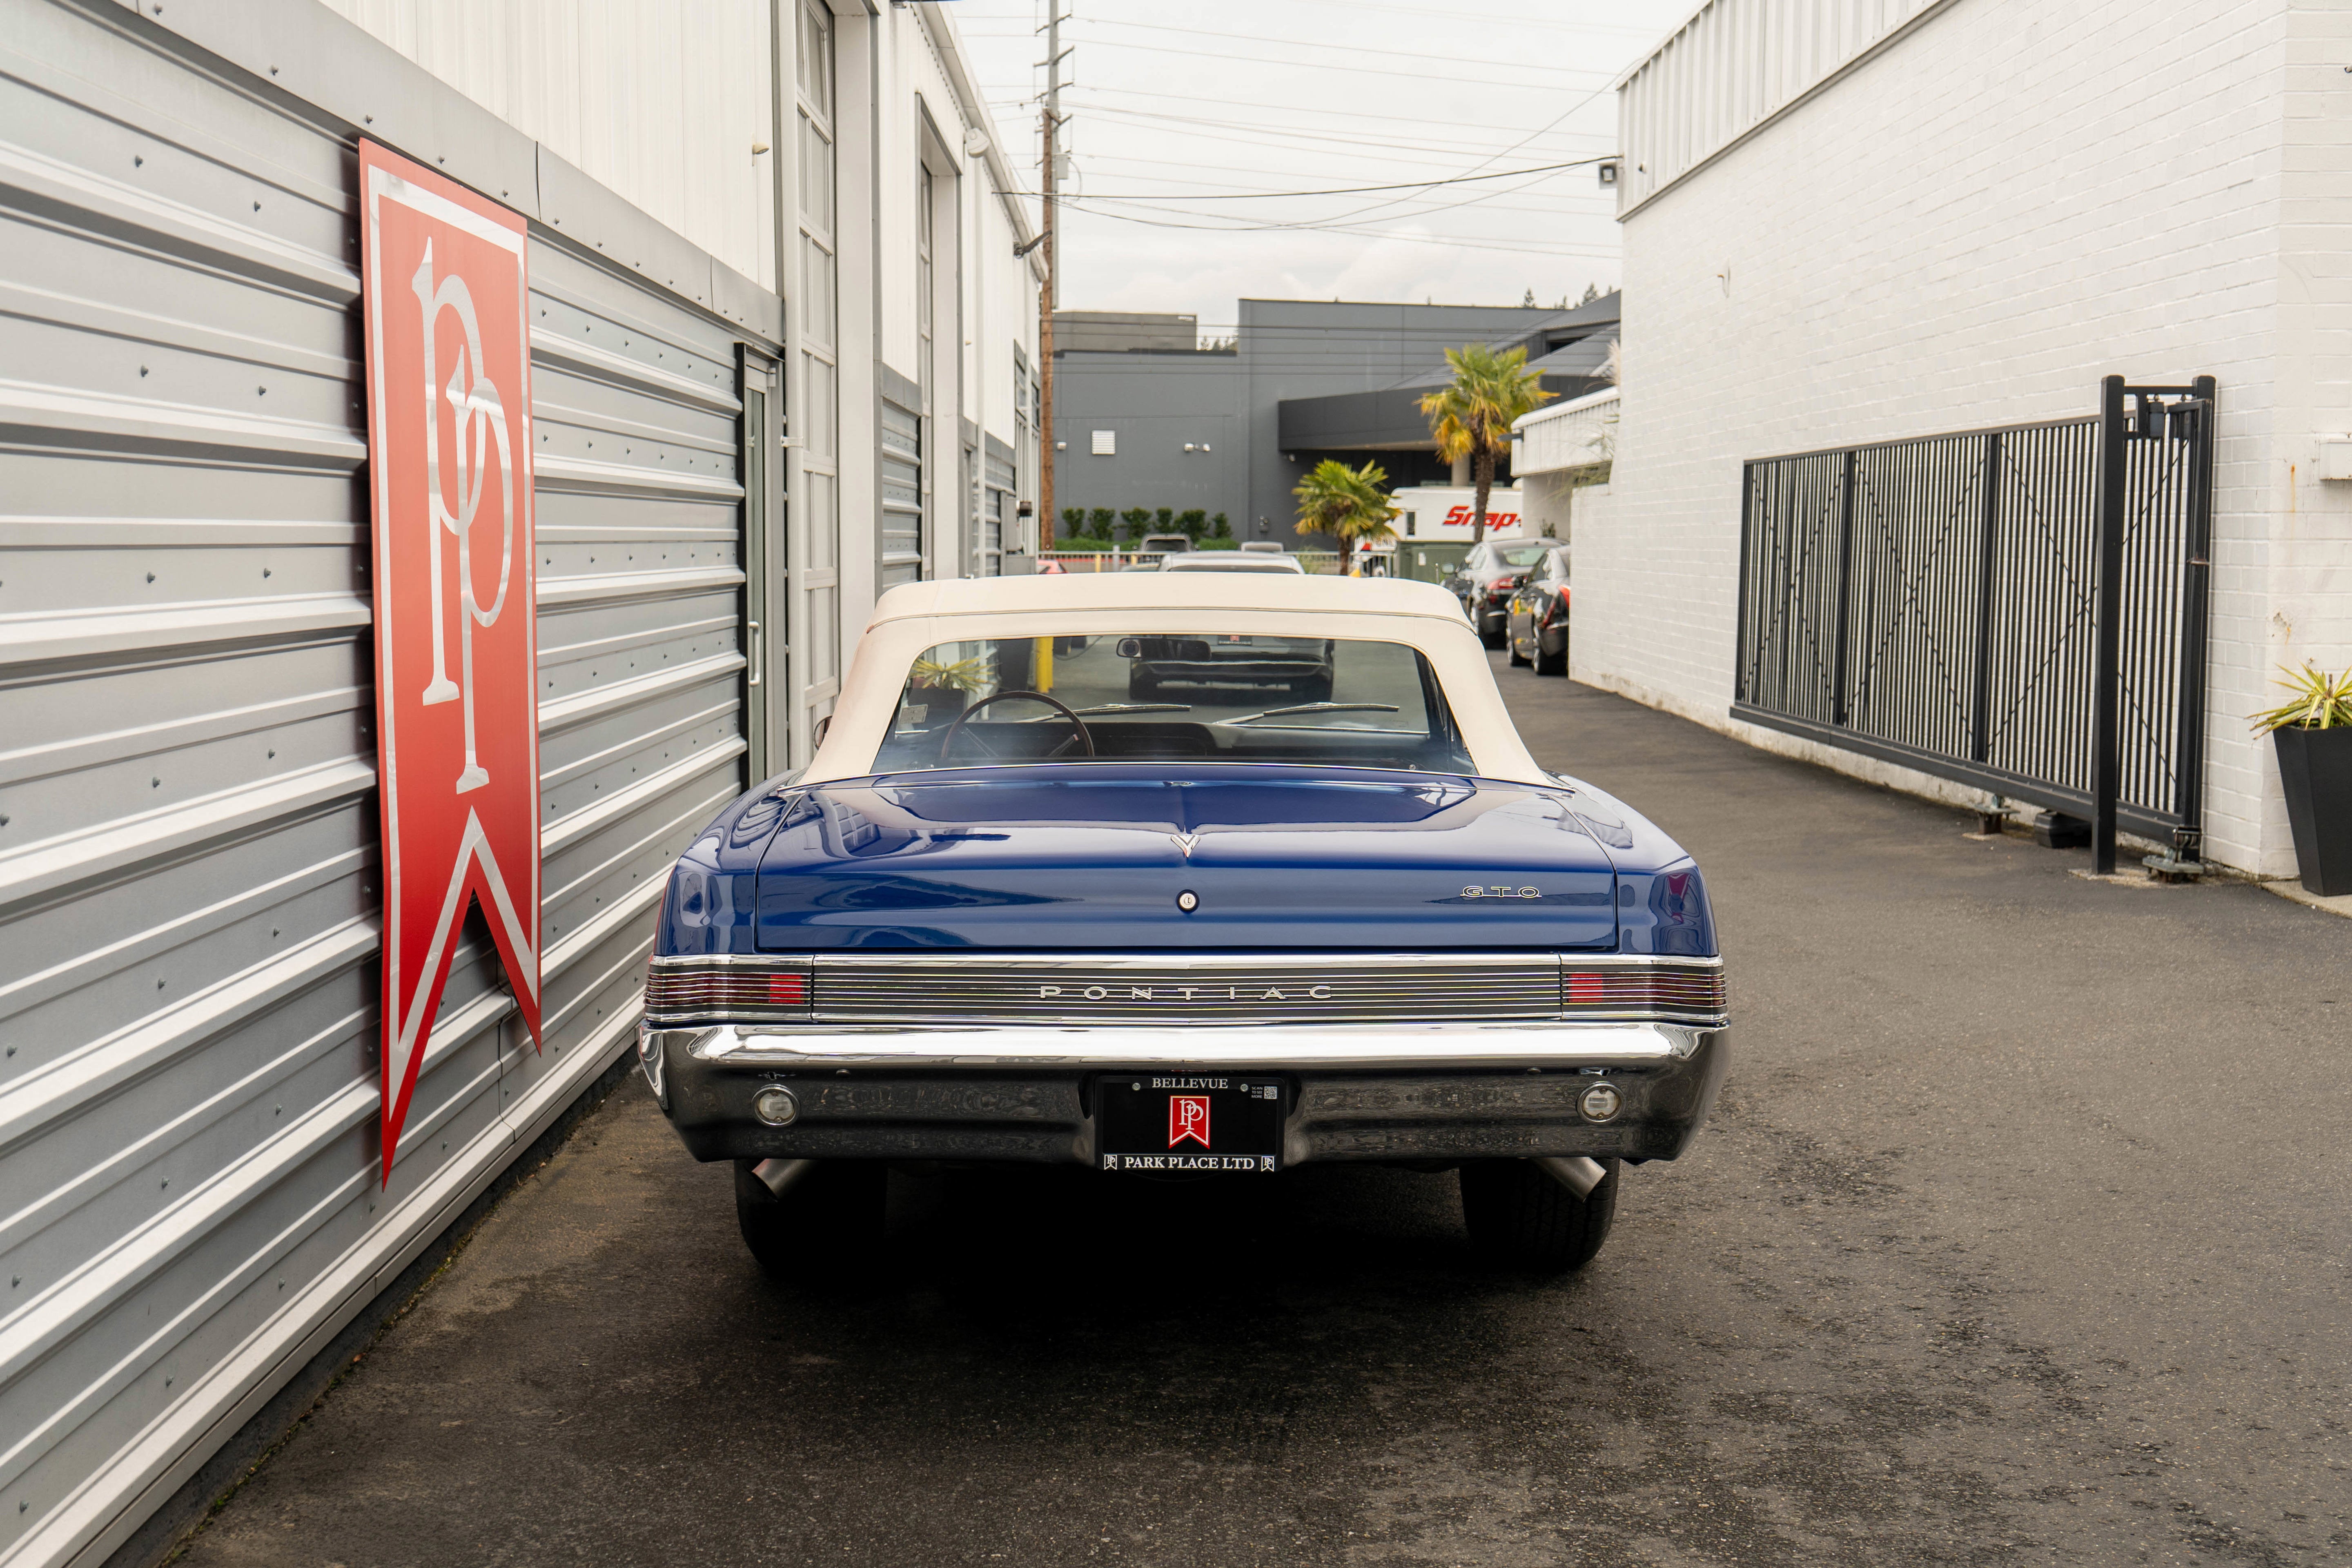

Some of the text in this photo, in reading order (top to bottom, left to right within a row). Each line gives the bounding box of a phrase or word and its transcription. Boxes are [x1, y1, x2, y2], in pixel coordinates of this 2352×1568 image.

[1461, 886, 1540, 898] GTO
[1040, 985, 1332, 1000] PONTIAC
[1152, 1078, 1228, 1089] BELLEVUE
[1125, 1157, 1255, 1169] PARK PLACE LTD
